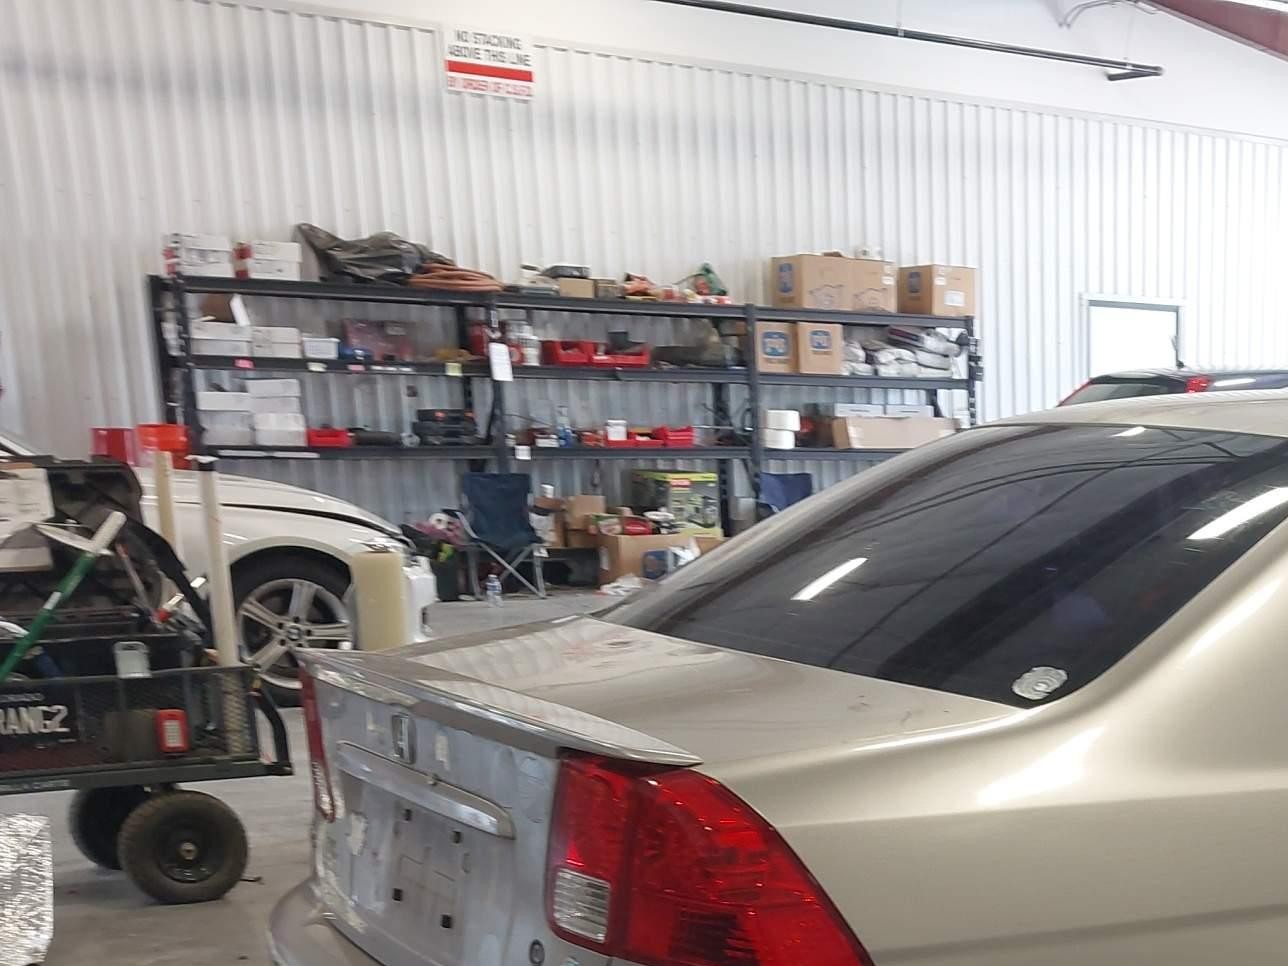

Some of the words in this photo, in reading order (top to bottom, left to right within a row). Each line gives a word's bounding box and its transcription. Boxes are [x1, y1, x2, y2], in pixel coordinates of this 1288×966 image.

[455, 29, 469, 43] NO
[472, 32, 522, 50] STACKING
[448, 45, 482, 60] ABOVE
[484, 49, 507, 64] THIS
[509, 51, 533, 67] LINE
